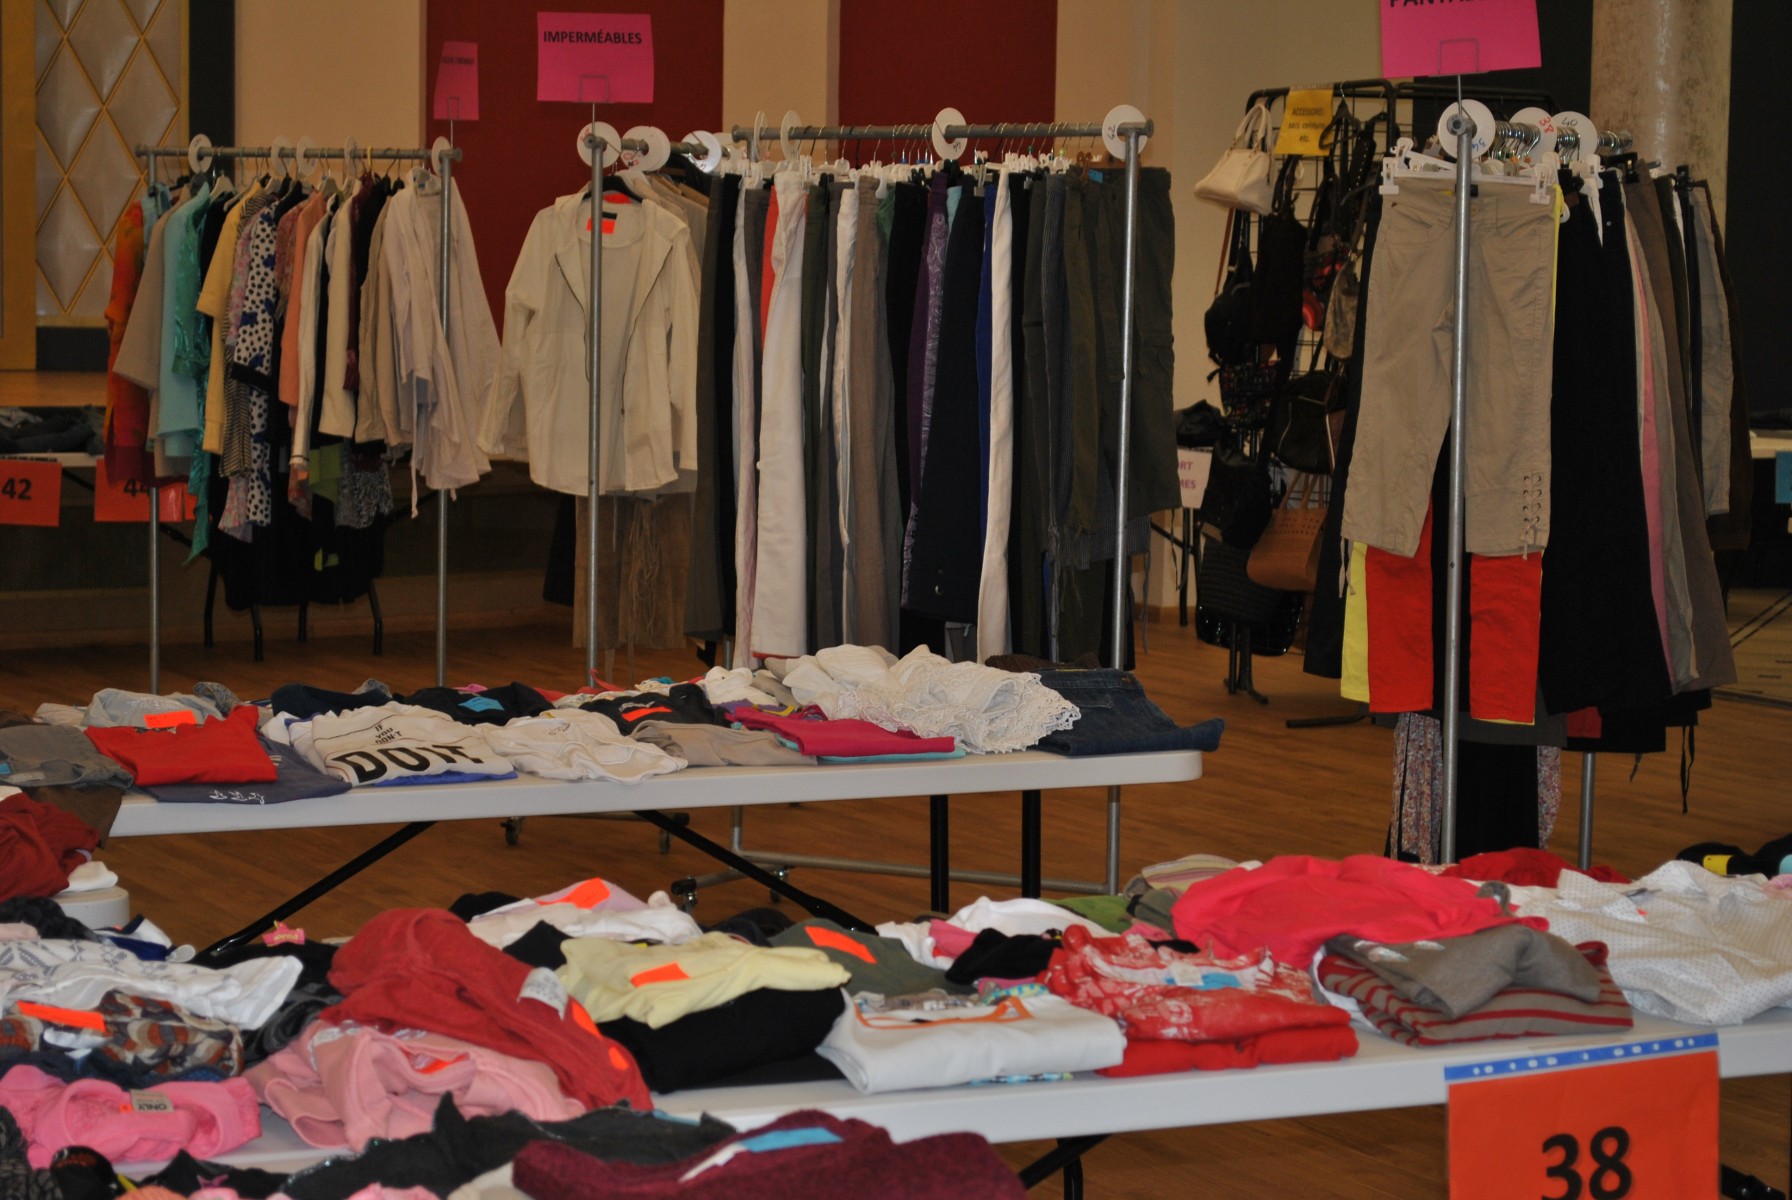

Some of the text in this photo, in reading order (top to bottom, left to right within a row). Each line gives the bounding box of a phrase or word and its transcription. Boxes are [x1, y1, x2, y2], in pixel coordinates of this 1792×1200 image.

[543, 29, 642, 44] IMPERMÉABLES
[1539, 116, 1555, 134] 38
[1561, 116, 1578, 127] 40
[2, 477, 32, 500] 42
[375, 723, 383, 732] IF
[375, 727, 394, 738] YOU
[1541, 1125, 1633, 1200] 38
